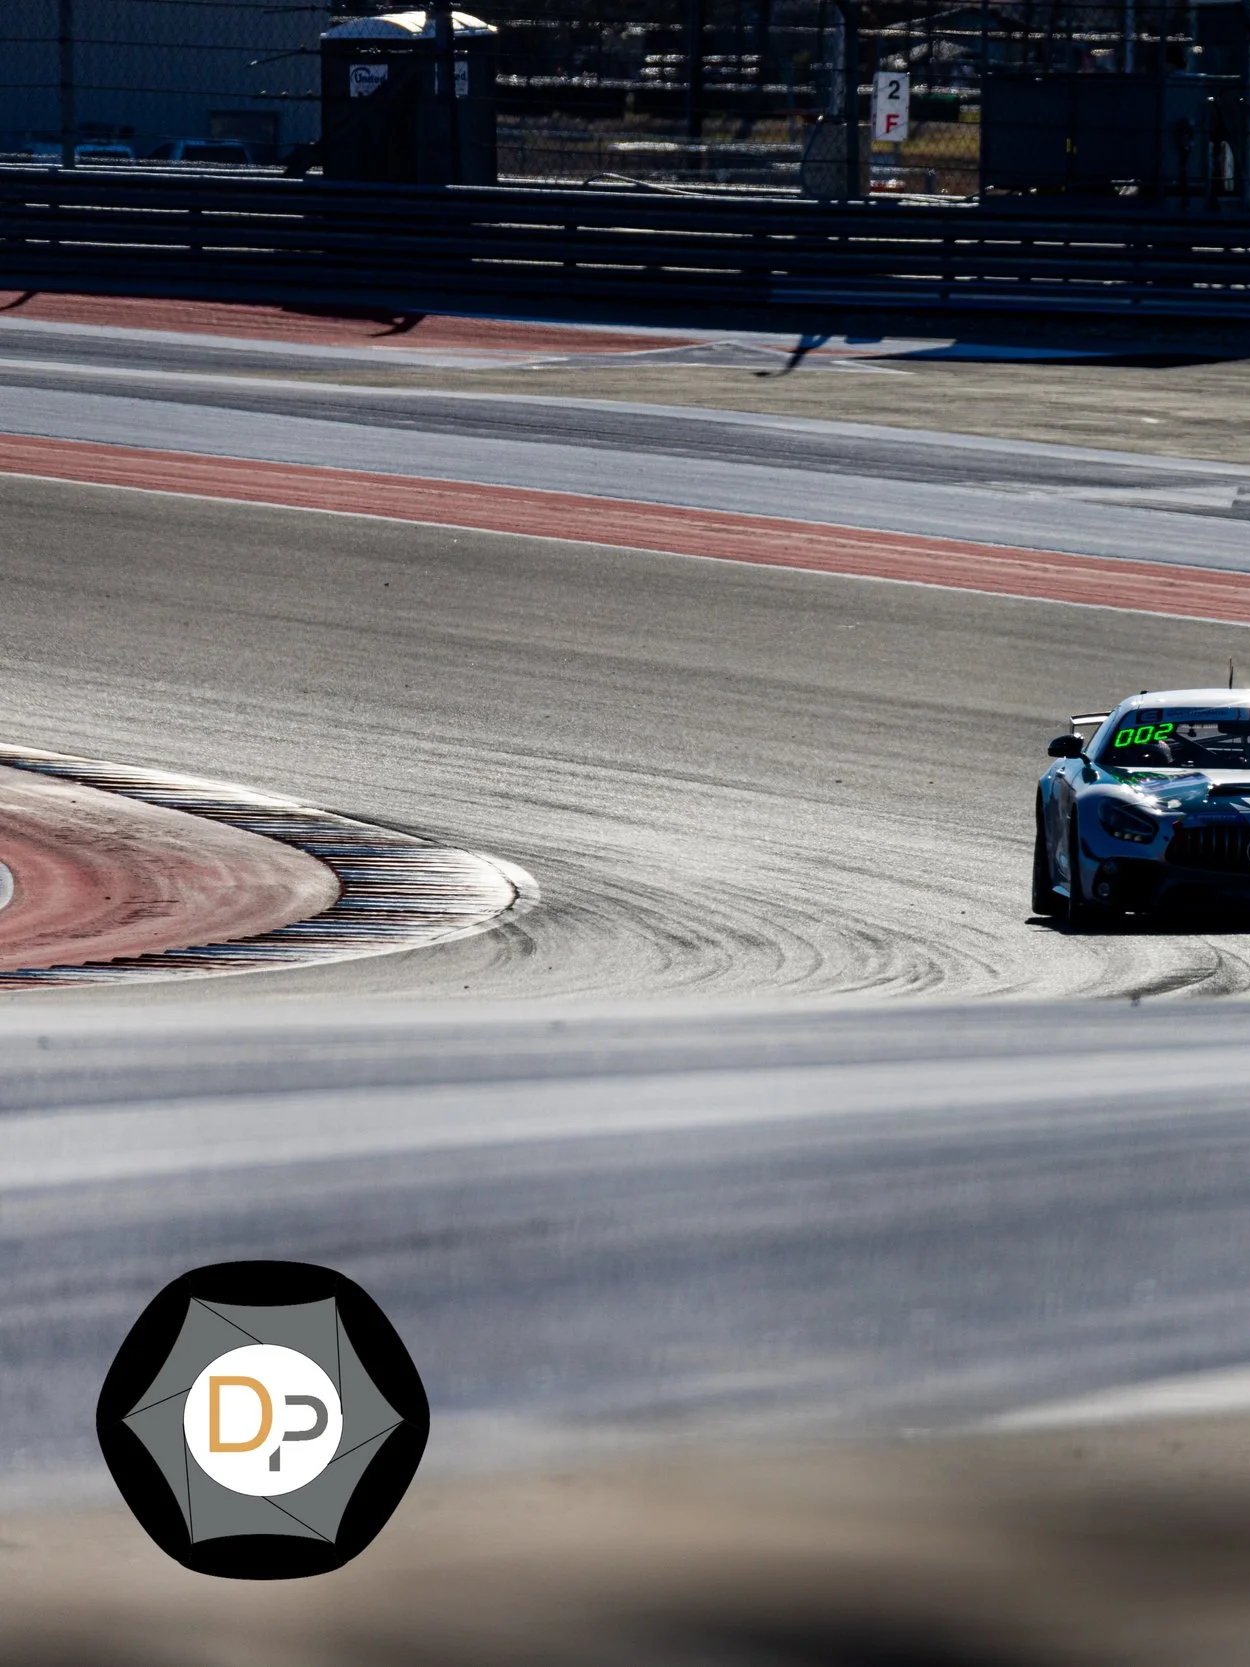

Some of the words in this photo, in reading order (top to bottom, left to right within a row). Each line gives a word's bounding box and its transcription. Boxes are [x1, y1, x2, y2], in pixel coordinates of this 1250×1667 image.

[888, 80, 900, 99] 2
[886, 114, 900, 134] F
[1114, 722, 1175, 748] 002
